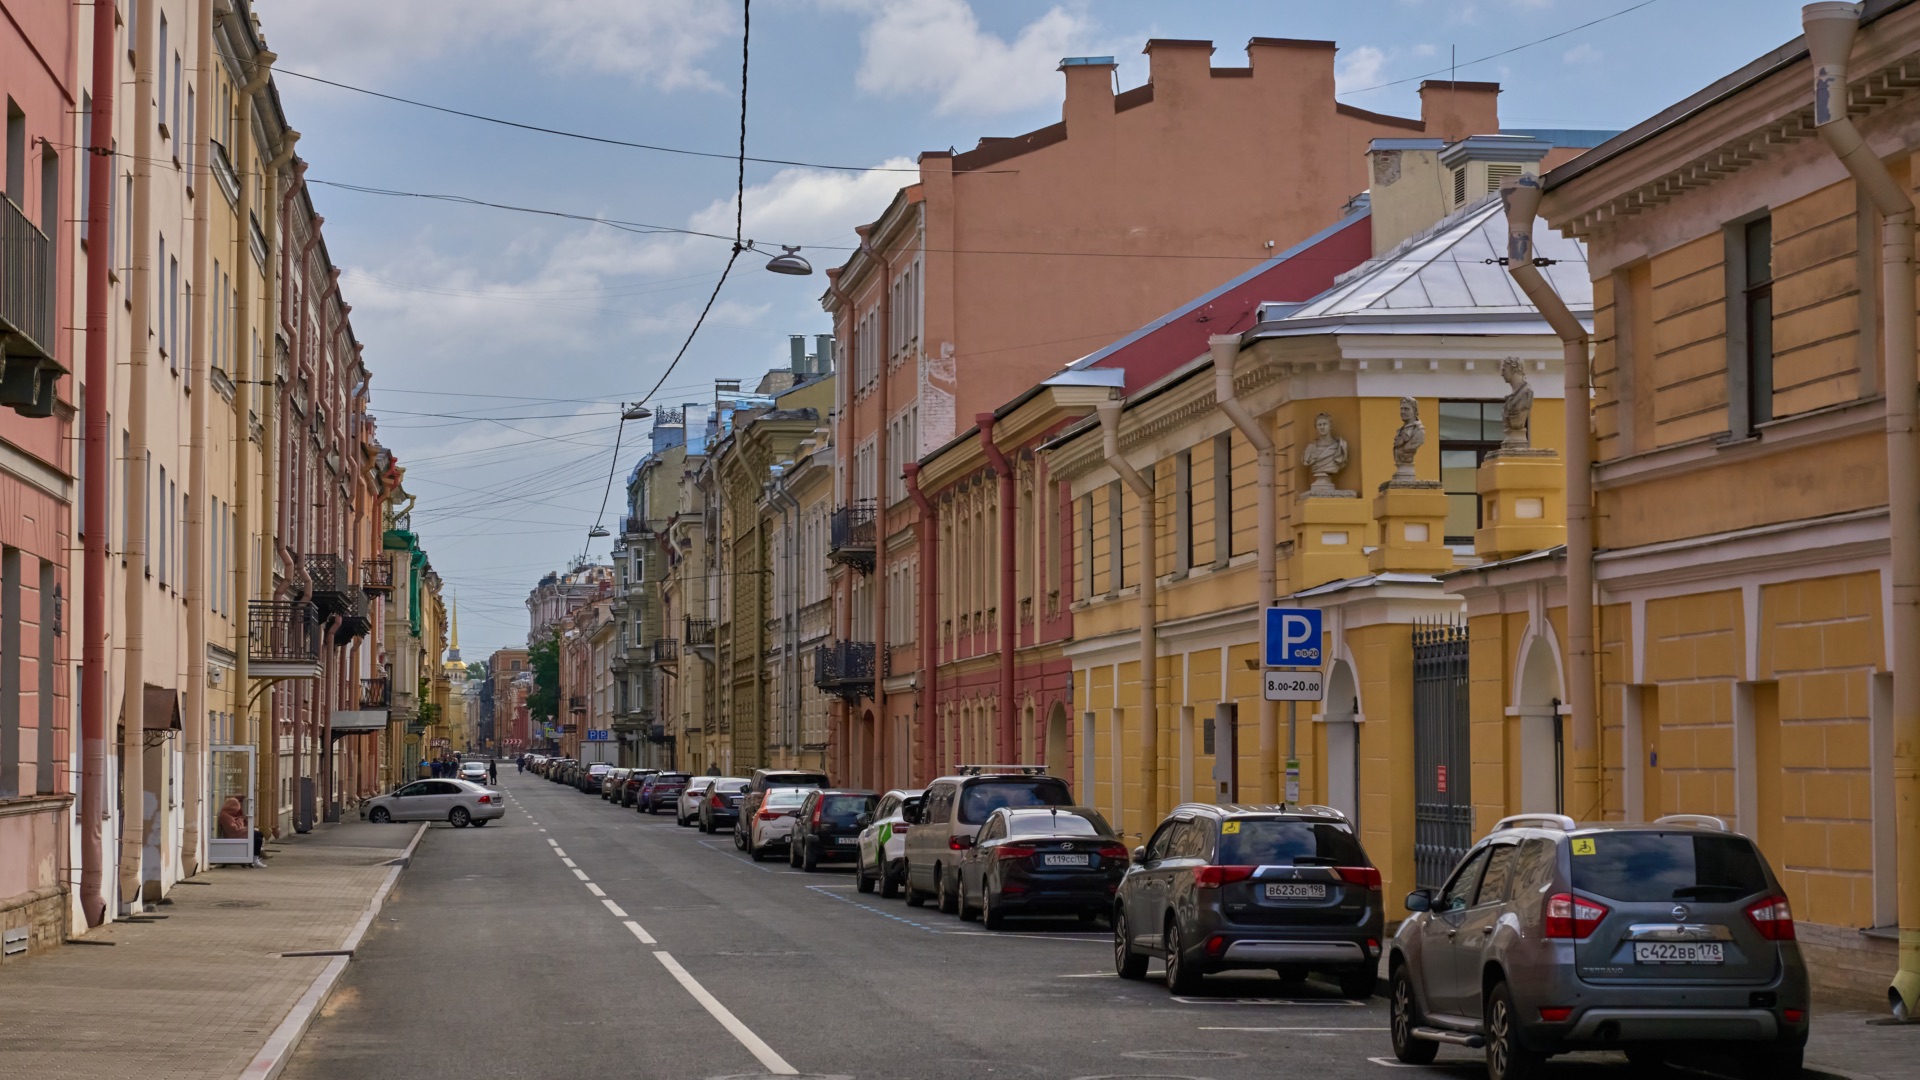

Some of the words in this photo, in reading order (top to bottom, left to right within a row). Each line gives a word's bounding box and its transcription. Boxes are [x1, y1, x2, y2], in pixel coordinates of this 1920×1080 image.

[1282, 615, 1312, 659] P
[1268, 680, 1319, 691] 8.00-20.00
[1310, 885, 1323, 893] 198
[1698, 944, 1719, 956] 178
